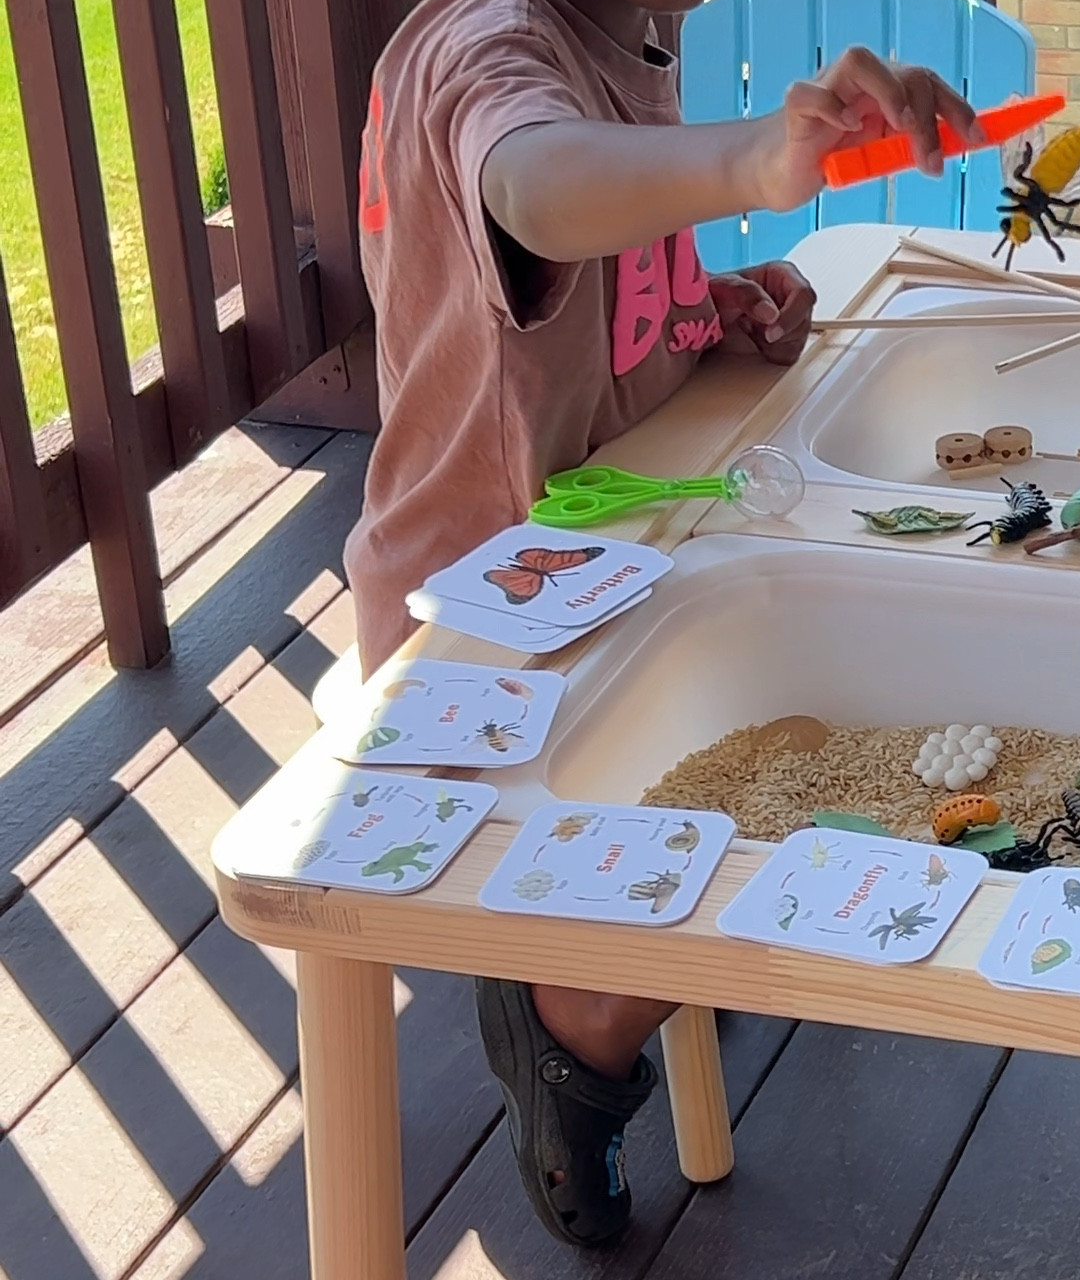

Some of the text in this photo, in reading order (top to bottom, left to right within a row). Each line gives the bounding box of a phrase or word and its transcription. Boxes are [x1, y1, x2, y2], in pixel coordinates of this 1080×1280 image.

[565, 564, 642, 610] Butterfly
[439, 704, 460, 723] Bee
[347, 813, 384, 838] Frog
[597, 844, 625, 873] Snail
[834, 863, 888, 920] Dragonfly
